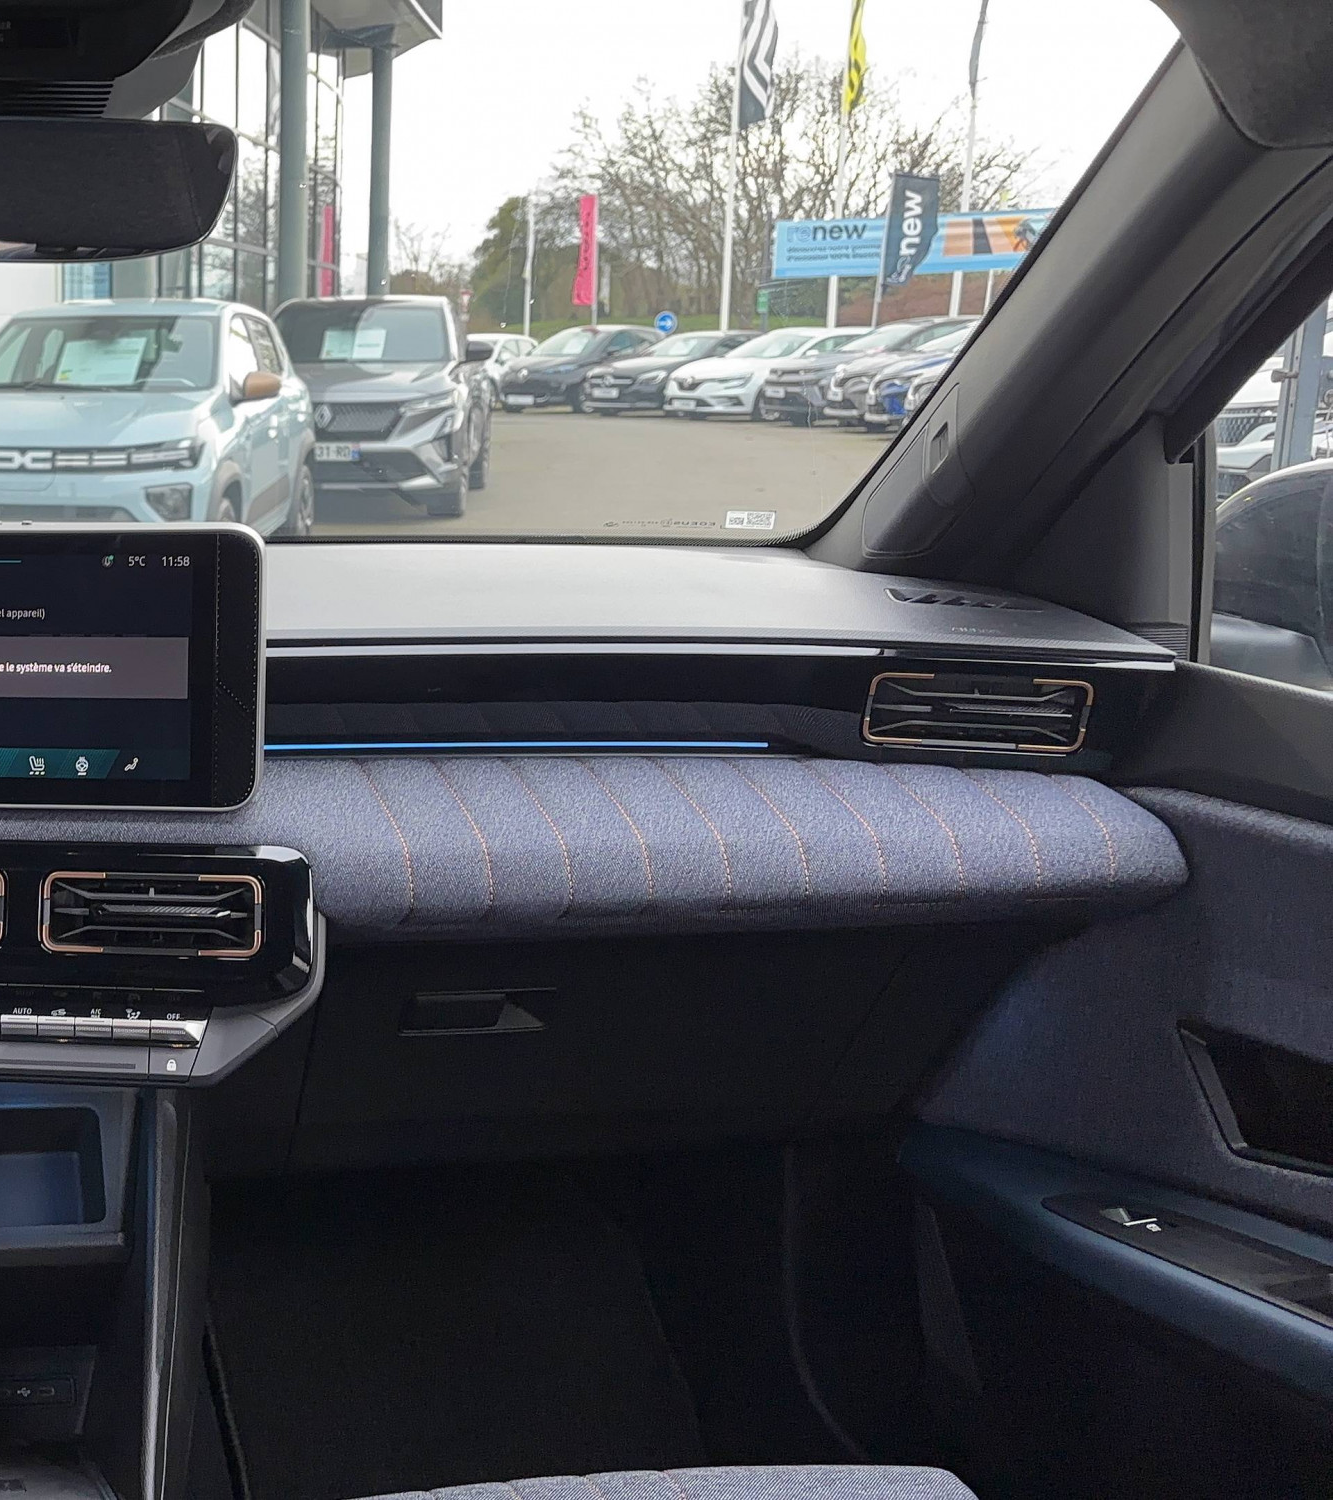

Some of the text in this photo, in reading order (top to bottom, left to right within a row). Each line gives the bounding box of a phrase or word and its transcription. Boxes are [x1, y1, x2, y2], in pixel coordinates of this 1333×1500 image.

[128, 556, 190, 567] 5°C 11:58
[6, 608, 46, 620] appareil)
[6, 662, 15, 672] le
[16, 662, 53, 674] système
[54, 664, 66, 672] va
[67, 663, 112, 673] s'éteindre.
[12, 1007, 33, 1015] AUTO
[166, 1013, 181, 1021] OFF
